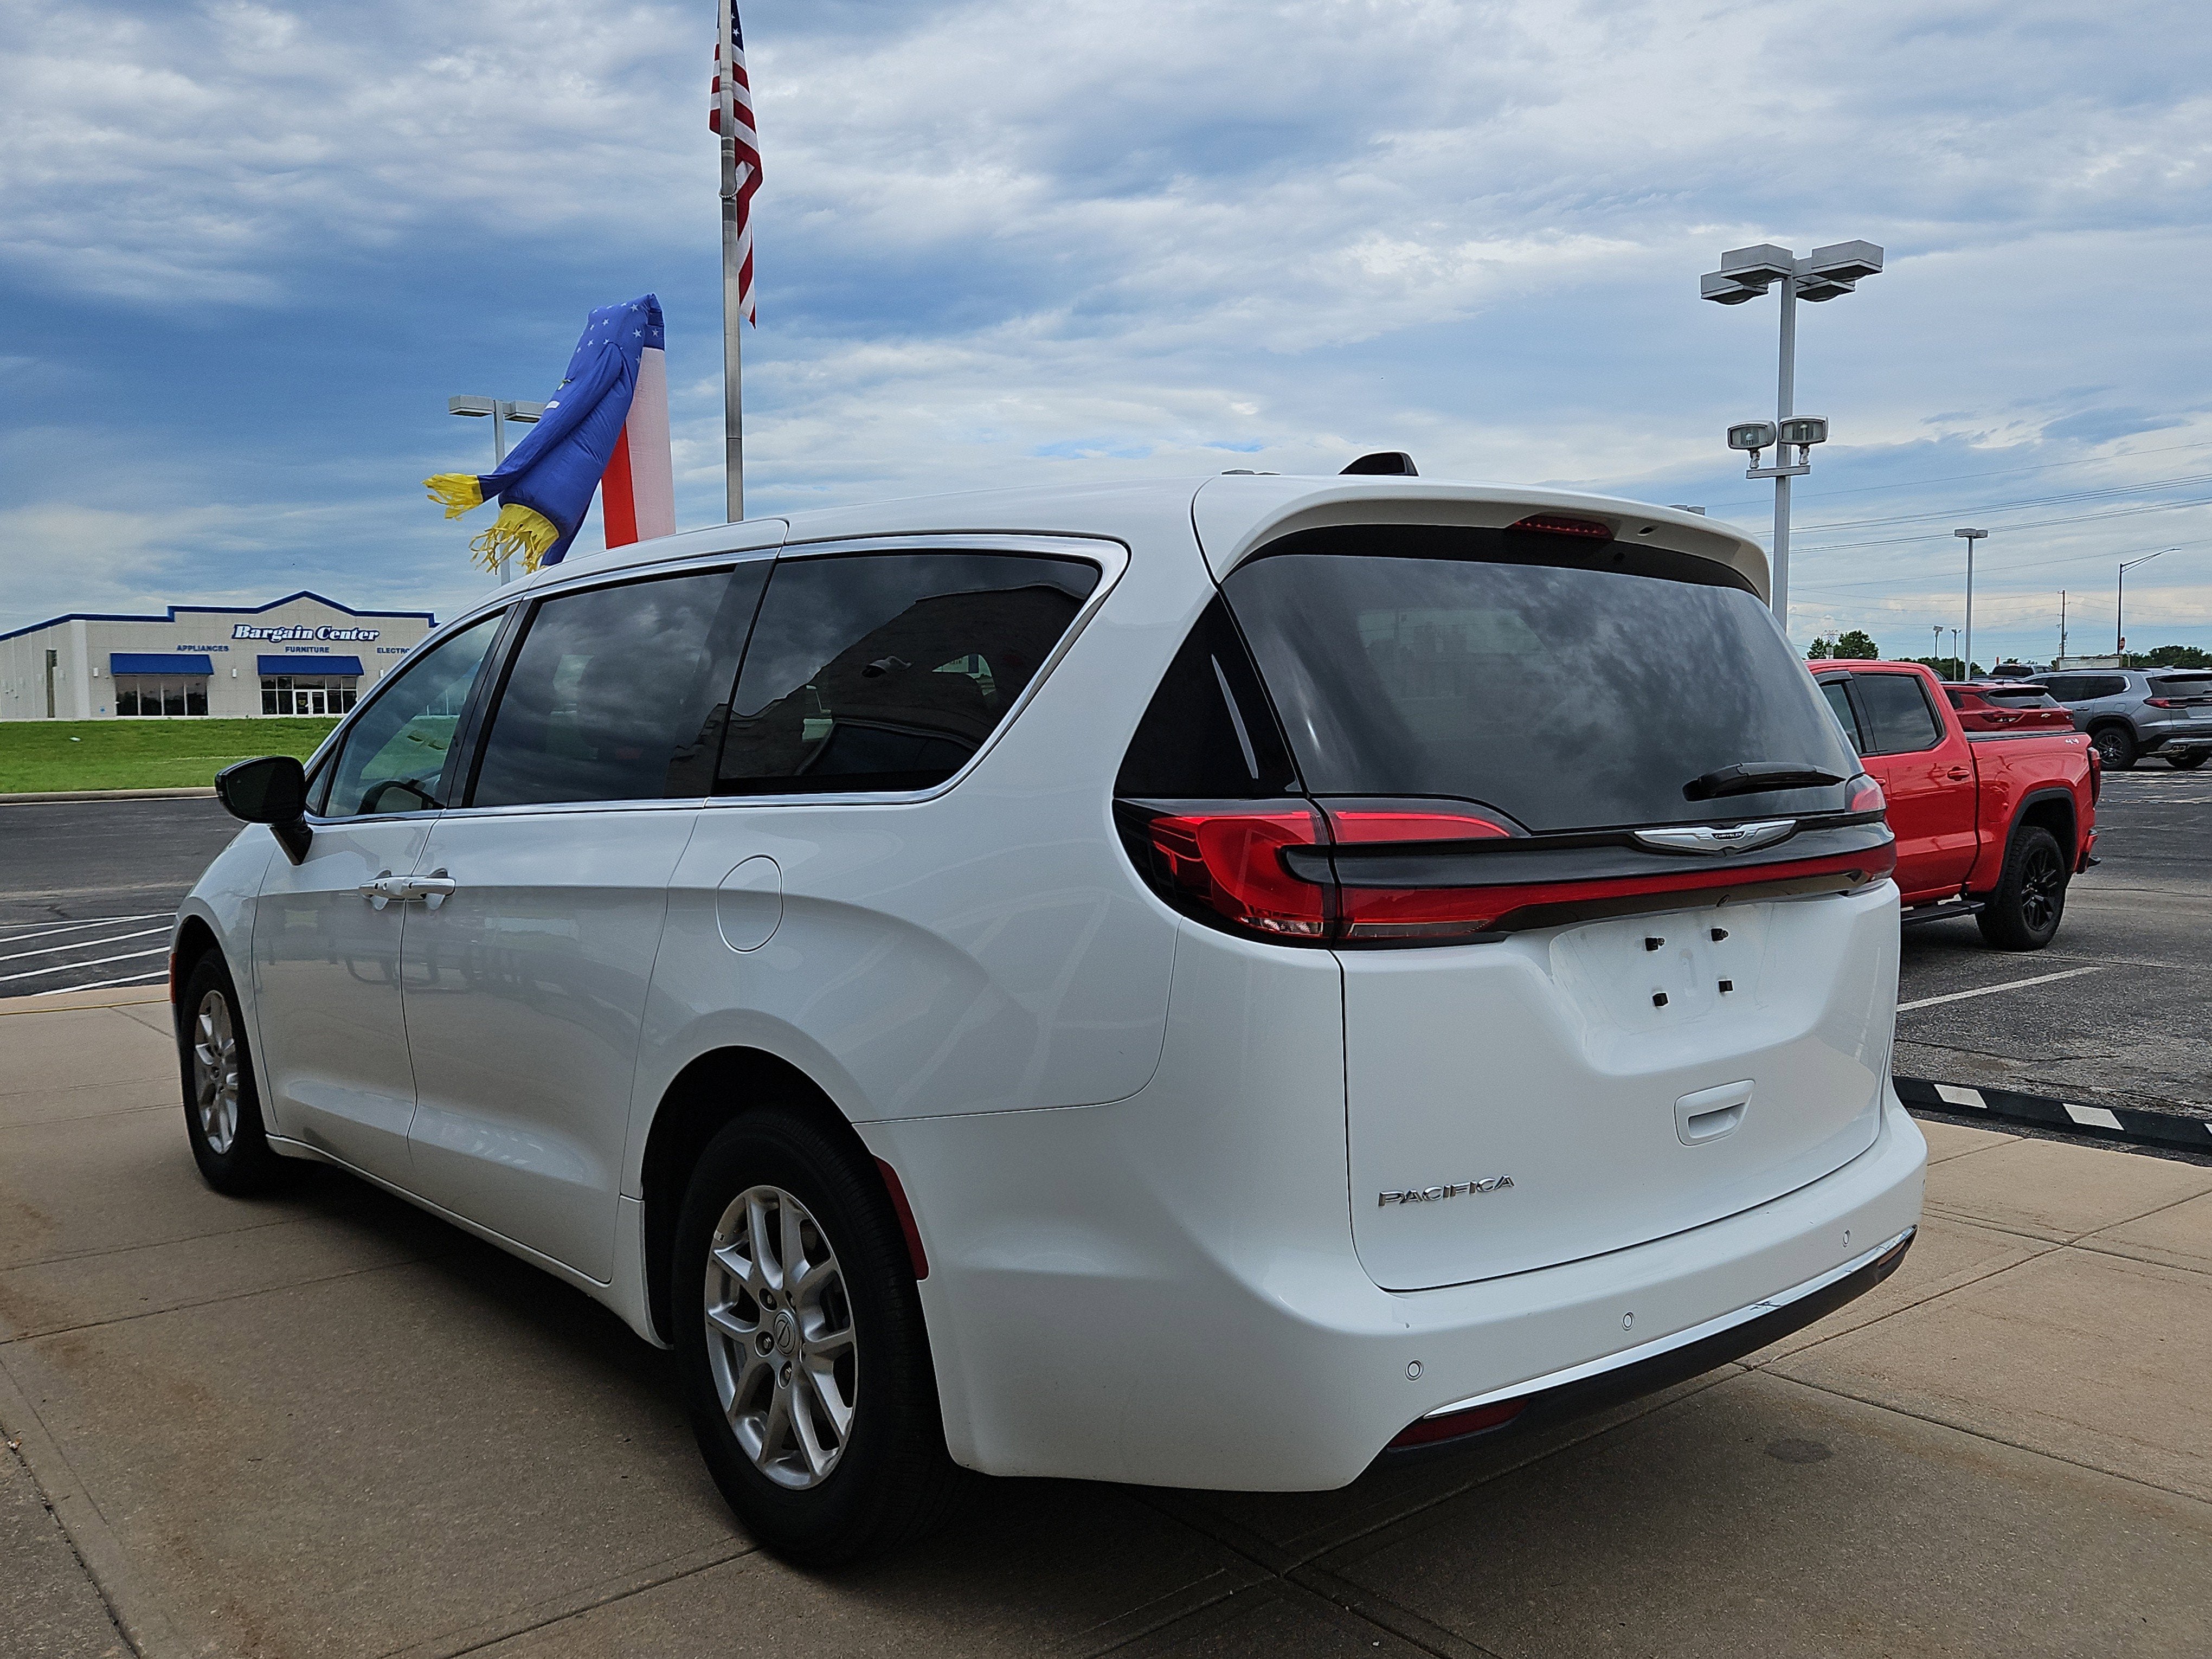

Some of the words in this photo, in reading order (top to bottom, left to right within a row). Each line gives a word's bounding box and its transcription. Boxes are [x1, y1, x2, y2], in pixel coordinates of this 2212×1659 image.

[232, 624, 313, 642] Bargain
[315, 626, 380, 641] Center
[1378, 1174, 1515, 1207] PACIFICA
